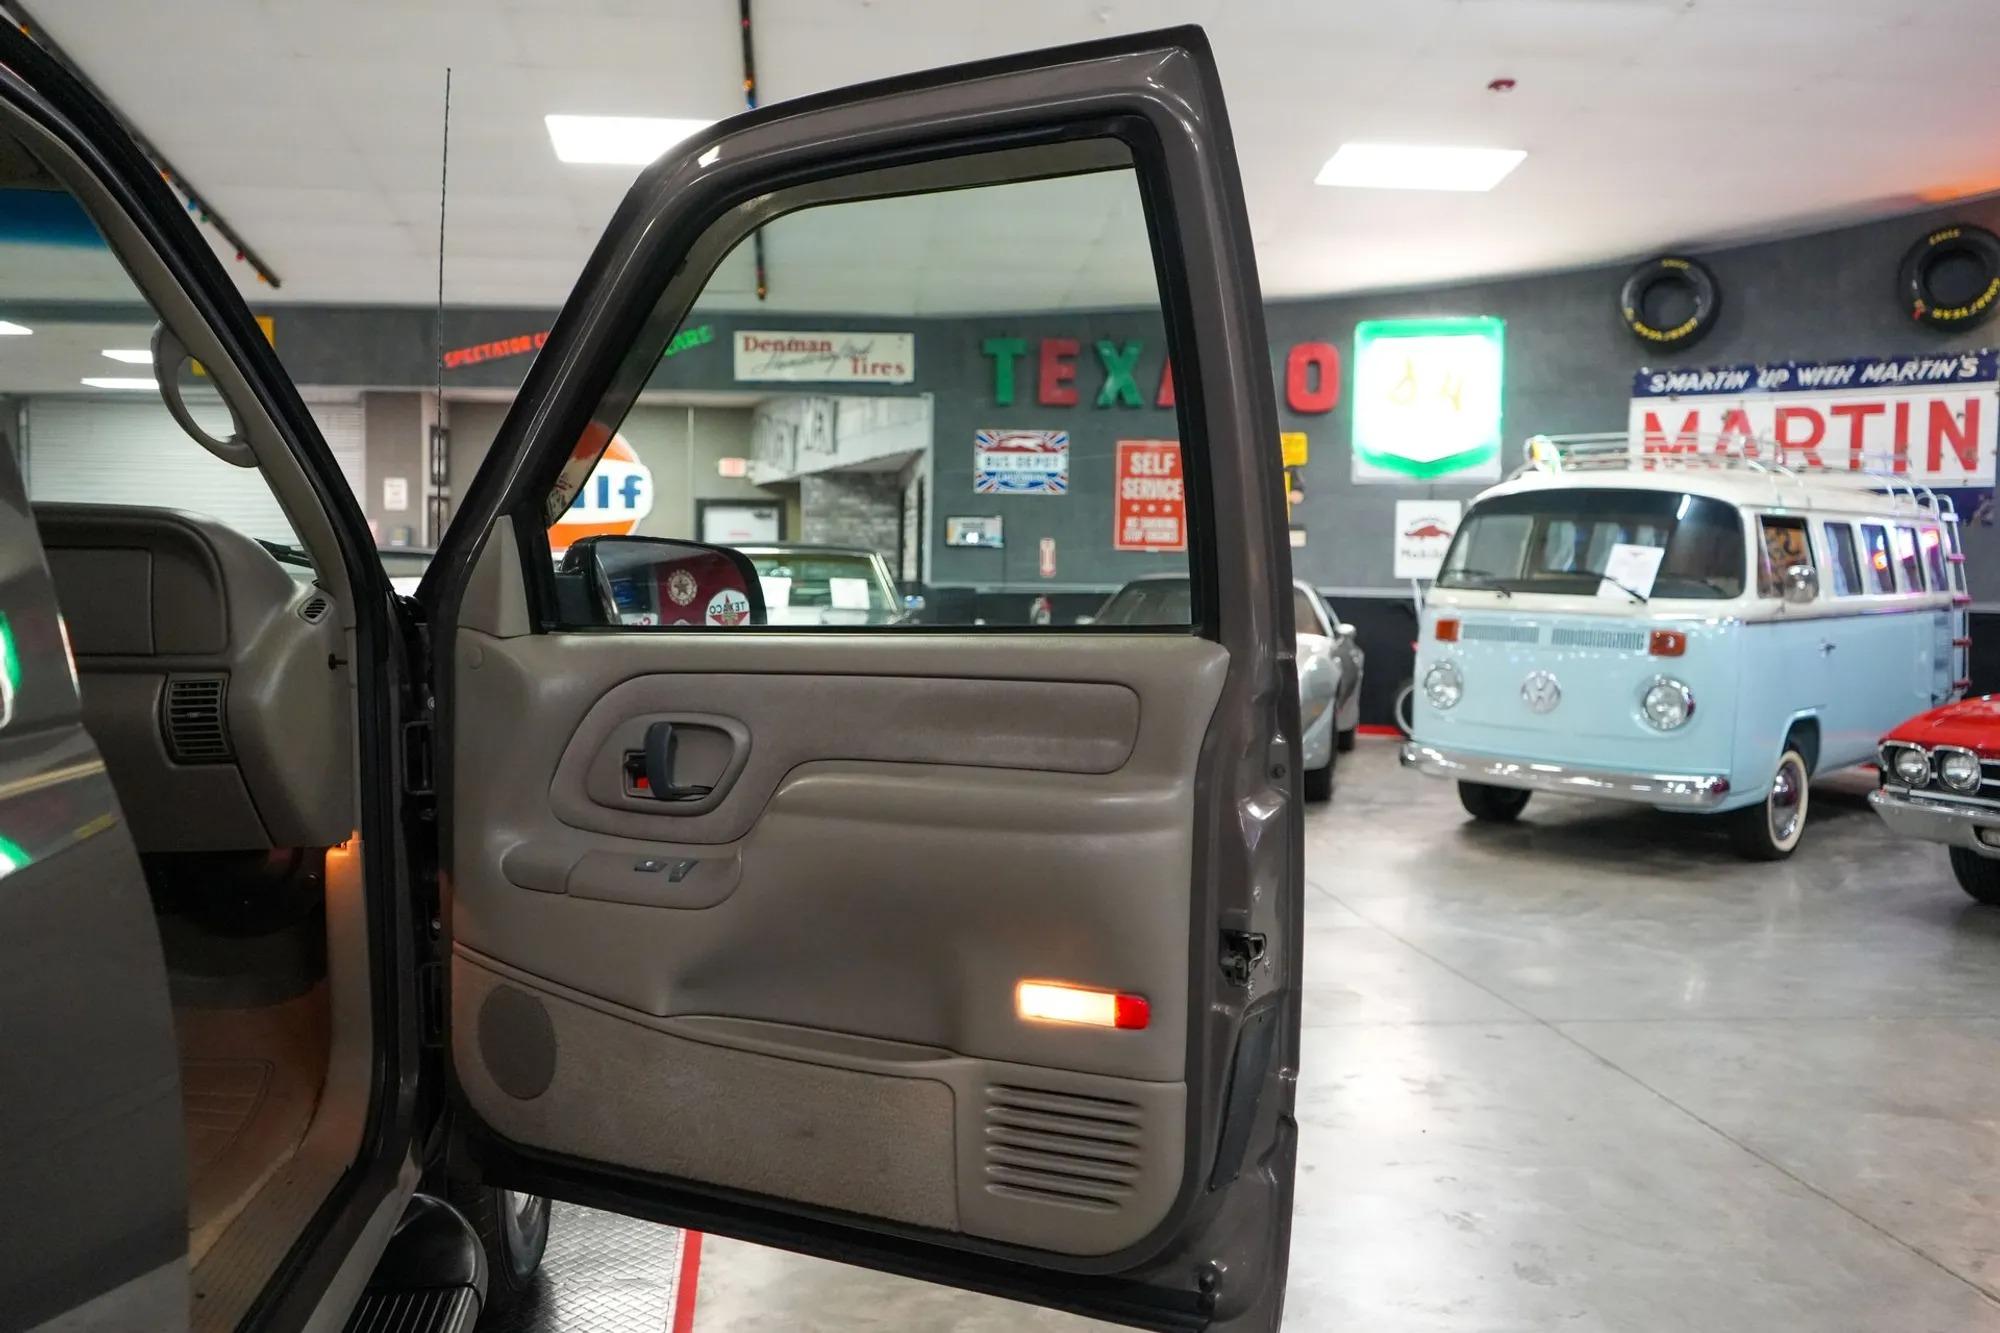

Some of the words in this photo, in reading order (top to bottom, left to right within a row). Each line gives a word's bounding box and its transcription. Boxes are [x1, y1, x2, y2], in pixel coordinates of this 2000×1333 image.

[743, 335, 832, 354] Denman
[851, 357, 905, 376] Tires
[983, 338, 1340, 414] TEXO
[1757, 367, 1790, 389] UP
[1797, 363, 1856, 387] WITH
[1859, 355, 1979, 384] MARTIN'S
[1644, 399, 1980, 472] MARTIN
[1130, 451, 1177, 475] SELF
[572, 475, 643, 508] lf
[1122, 478, 1184, 500] SERVICE
